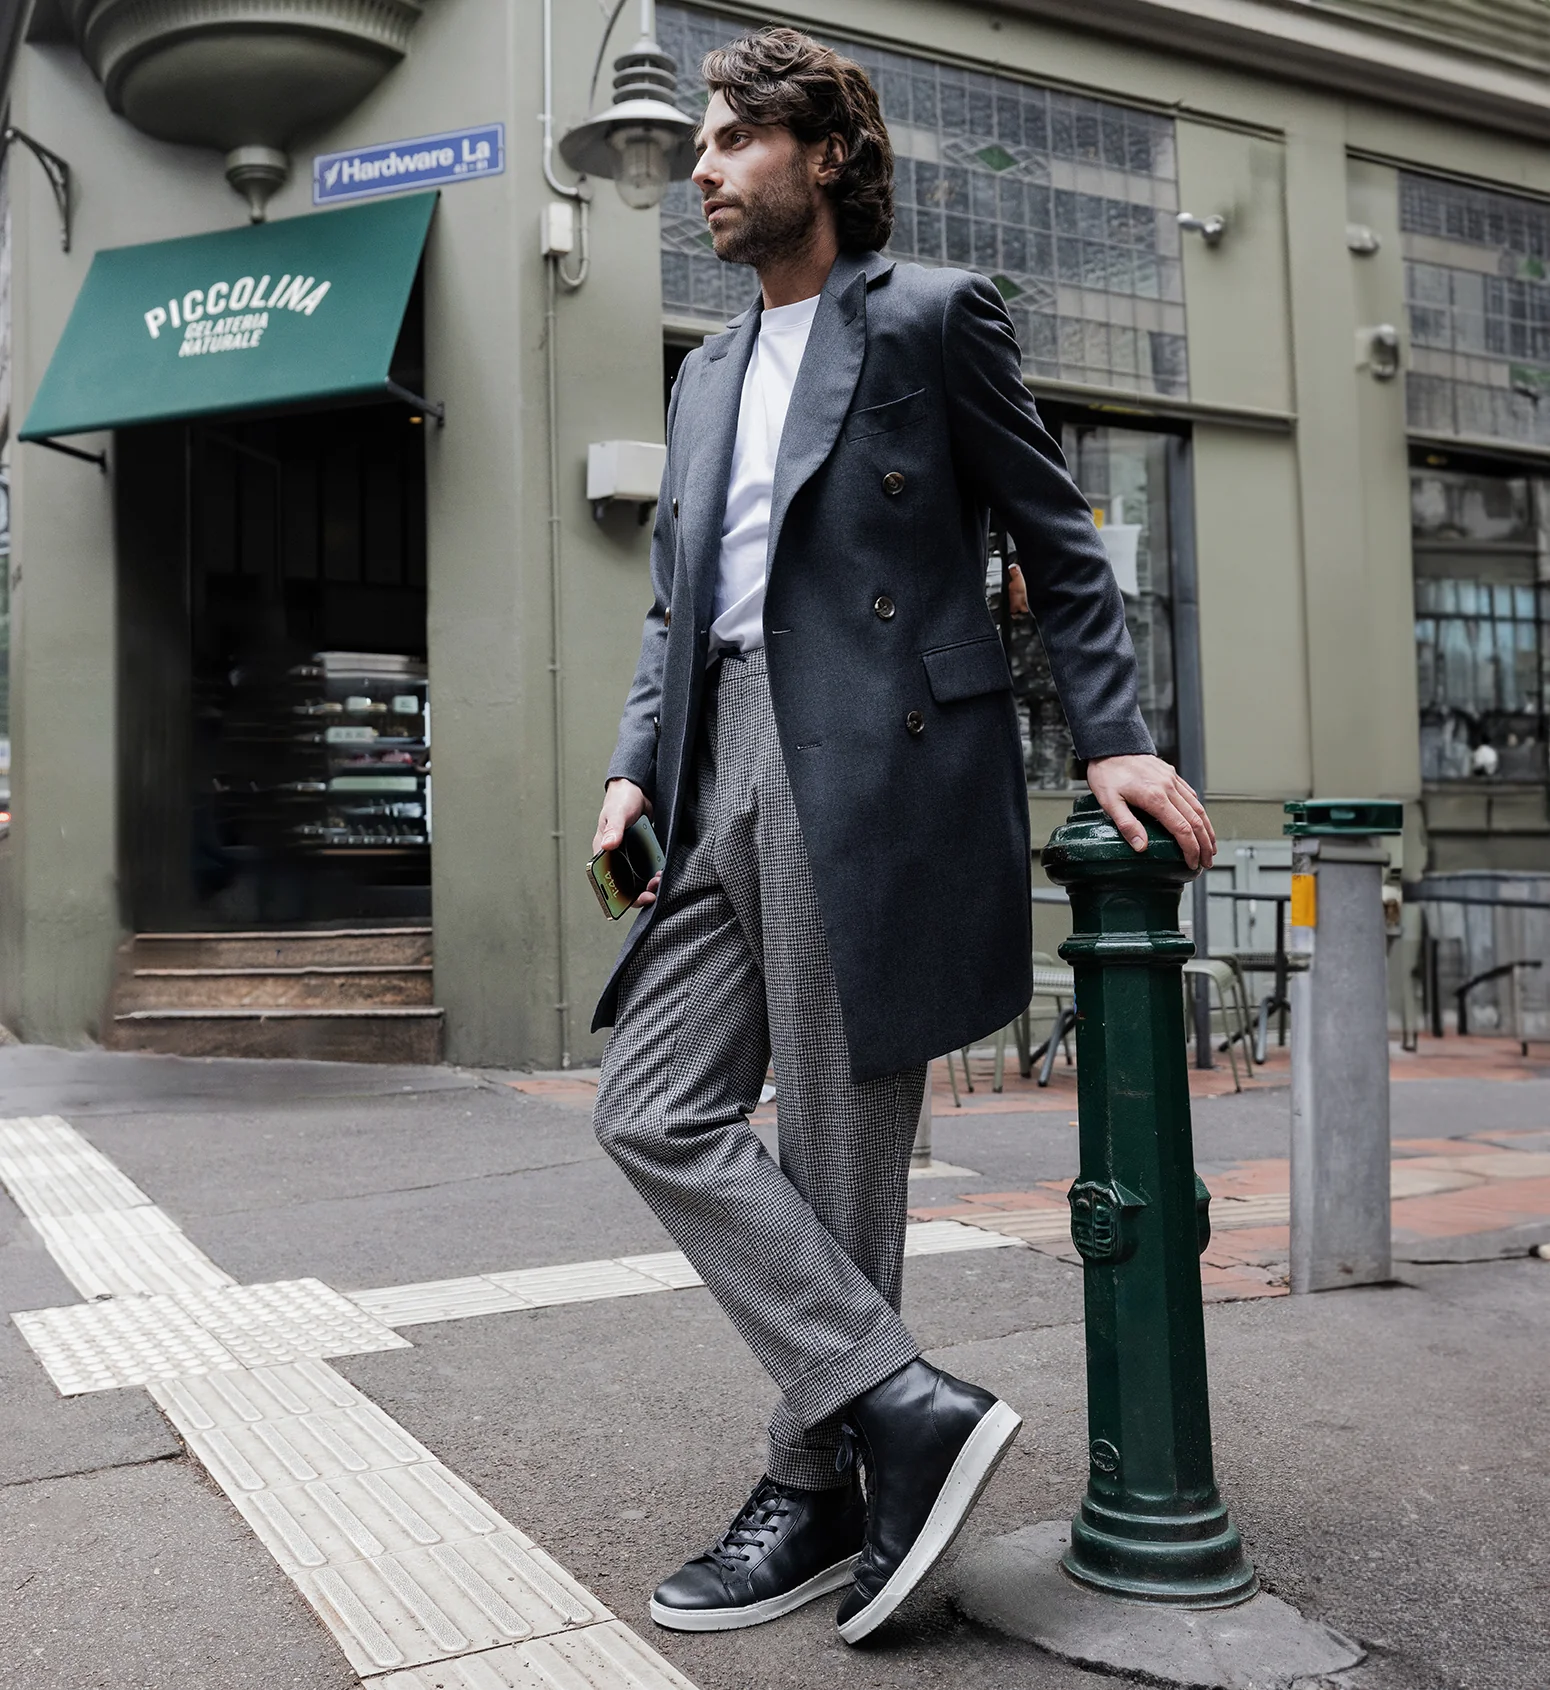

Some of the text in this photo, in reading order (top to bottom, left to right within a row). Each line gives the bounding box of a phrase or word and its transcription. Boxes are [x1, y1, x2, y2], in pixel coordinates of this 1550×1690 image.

[341, 147, 454, 184] Hardware
[461, 138, 491, 163] La
[144, 274, 331, 339] PICCOLINA
[178, 328, 264, 358] NATURALE
[184, 311, 269, 341] GELATERIA
